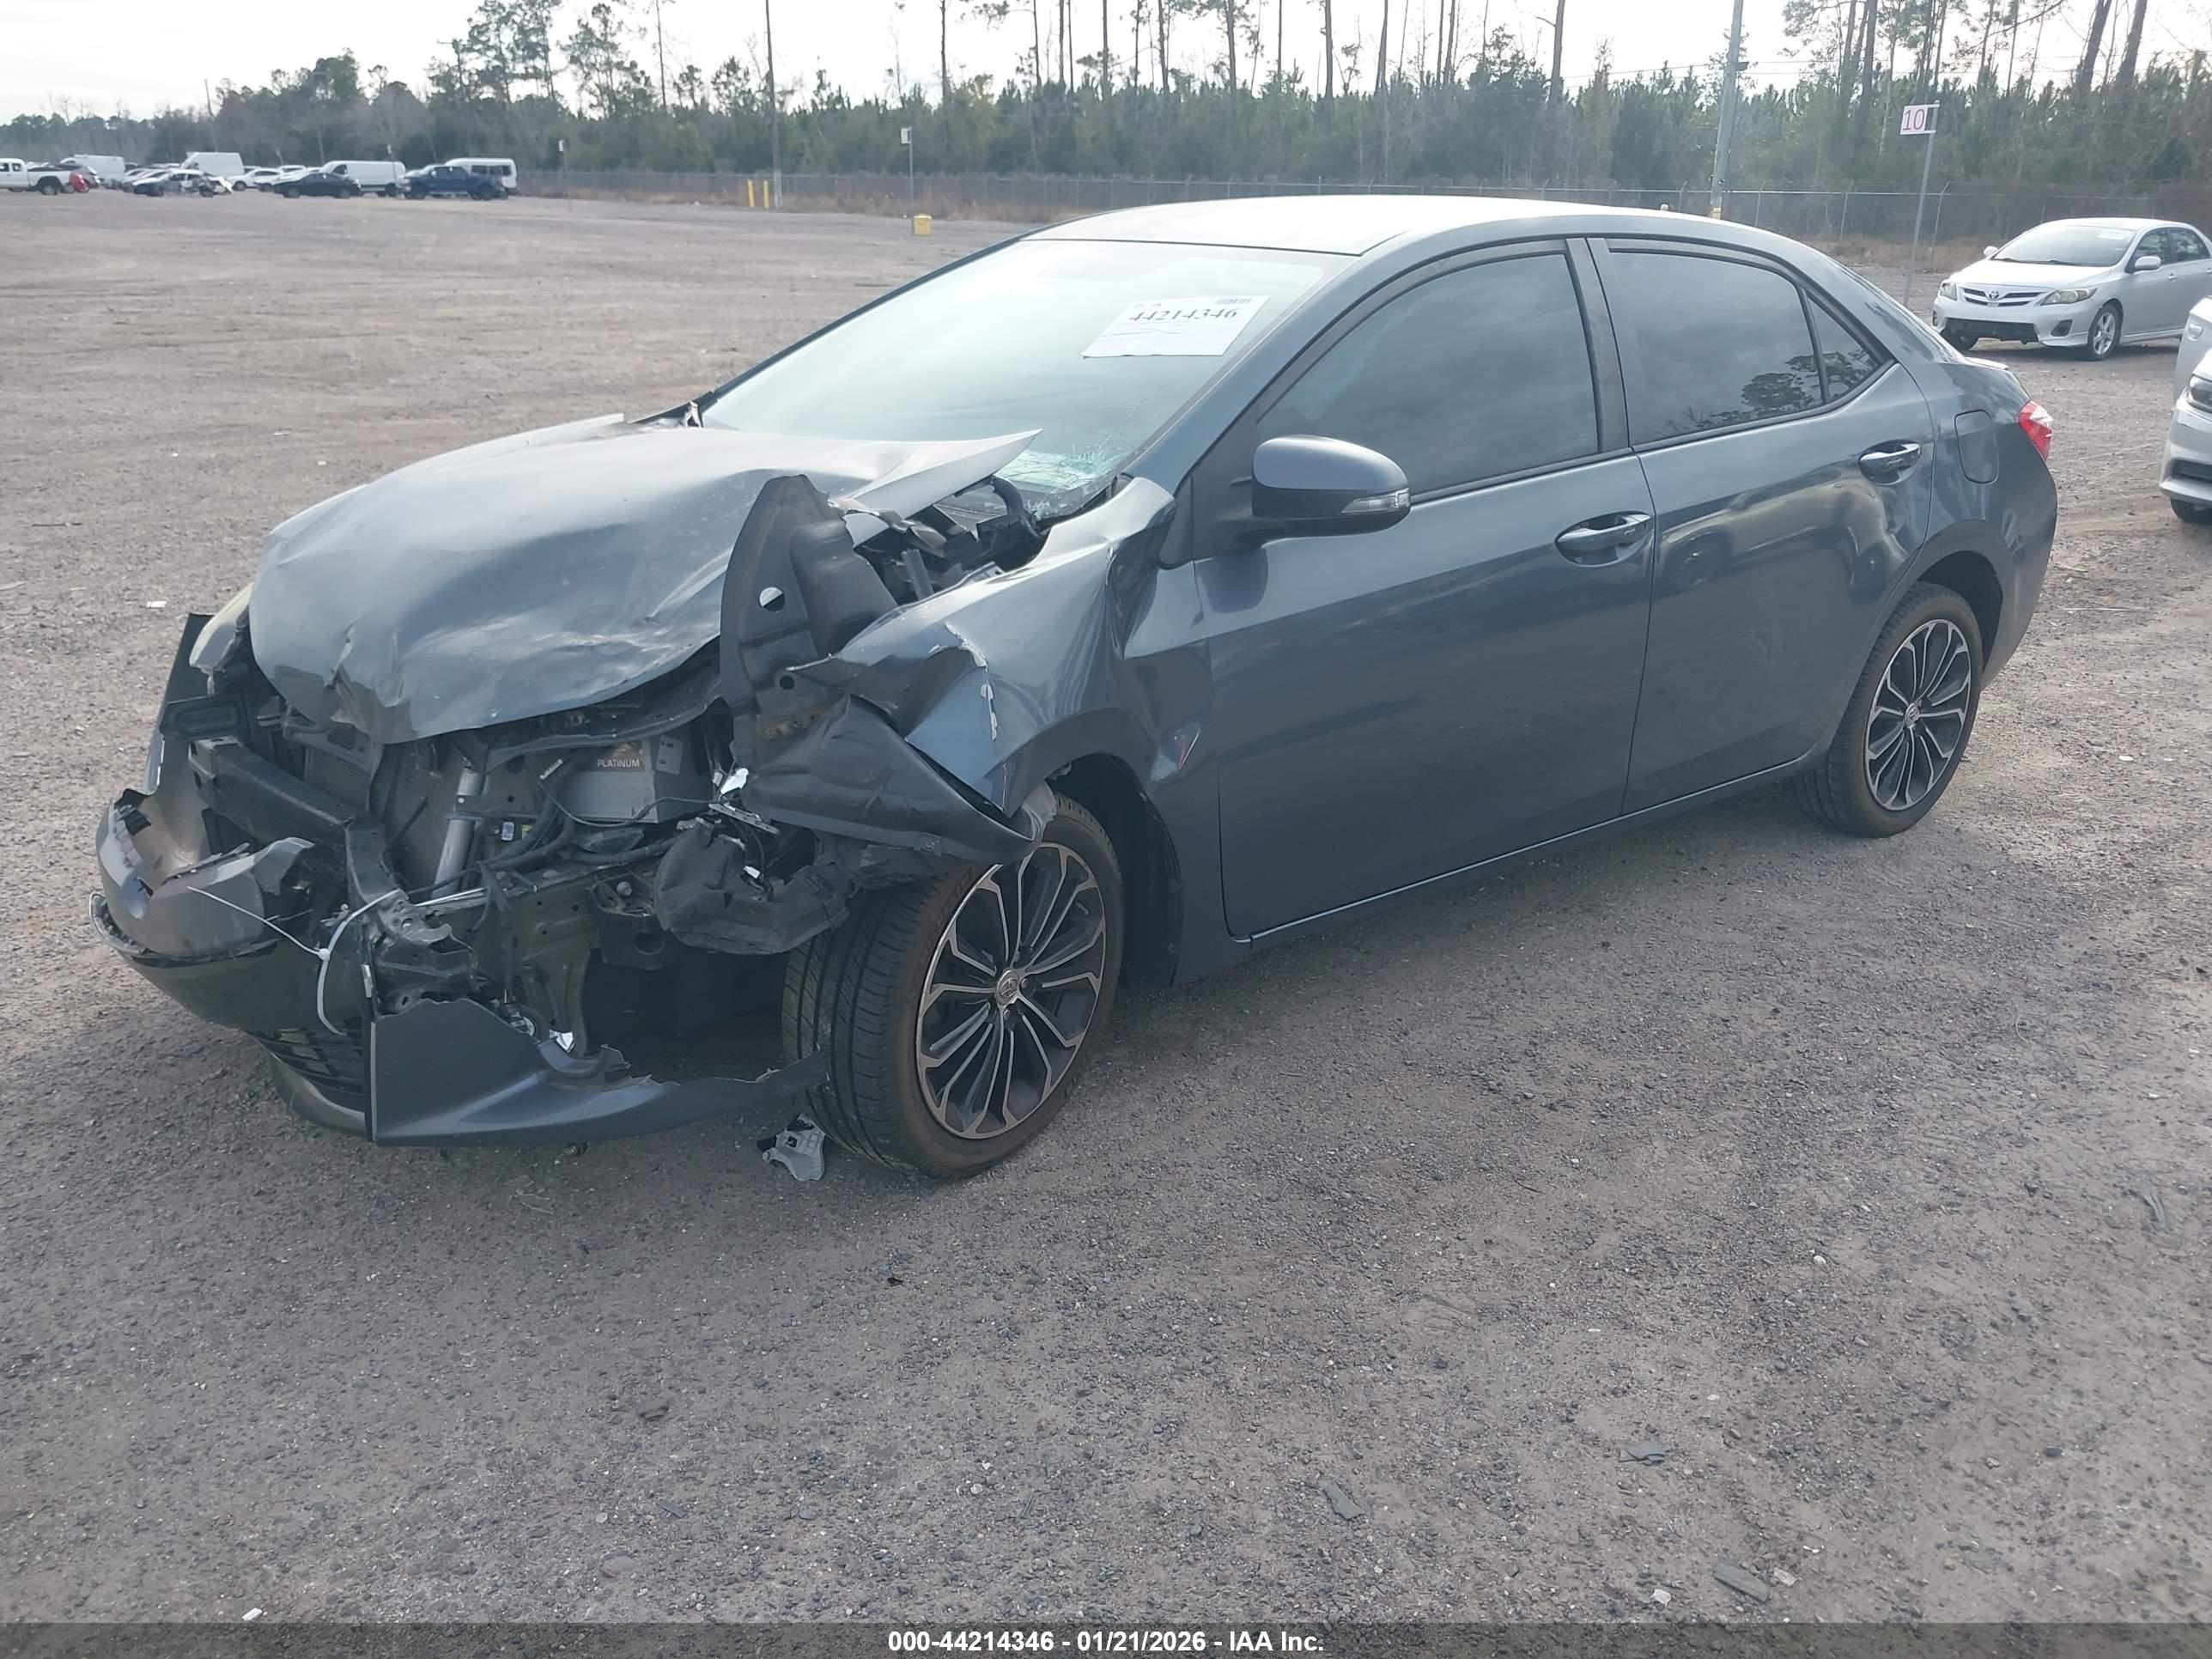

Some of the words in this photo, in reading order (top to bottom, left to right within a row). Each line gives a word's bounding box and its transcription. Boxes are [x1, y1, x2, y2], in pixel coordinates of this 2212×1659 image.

[1902, 108, 1925, 131] 10
[1128, 307, 1239, 321] 44214346
[597, 758, 641, 769] PLATINUM
